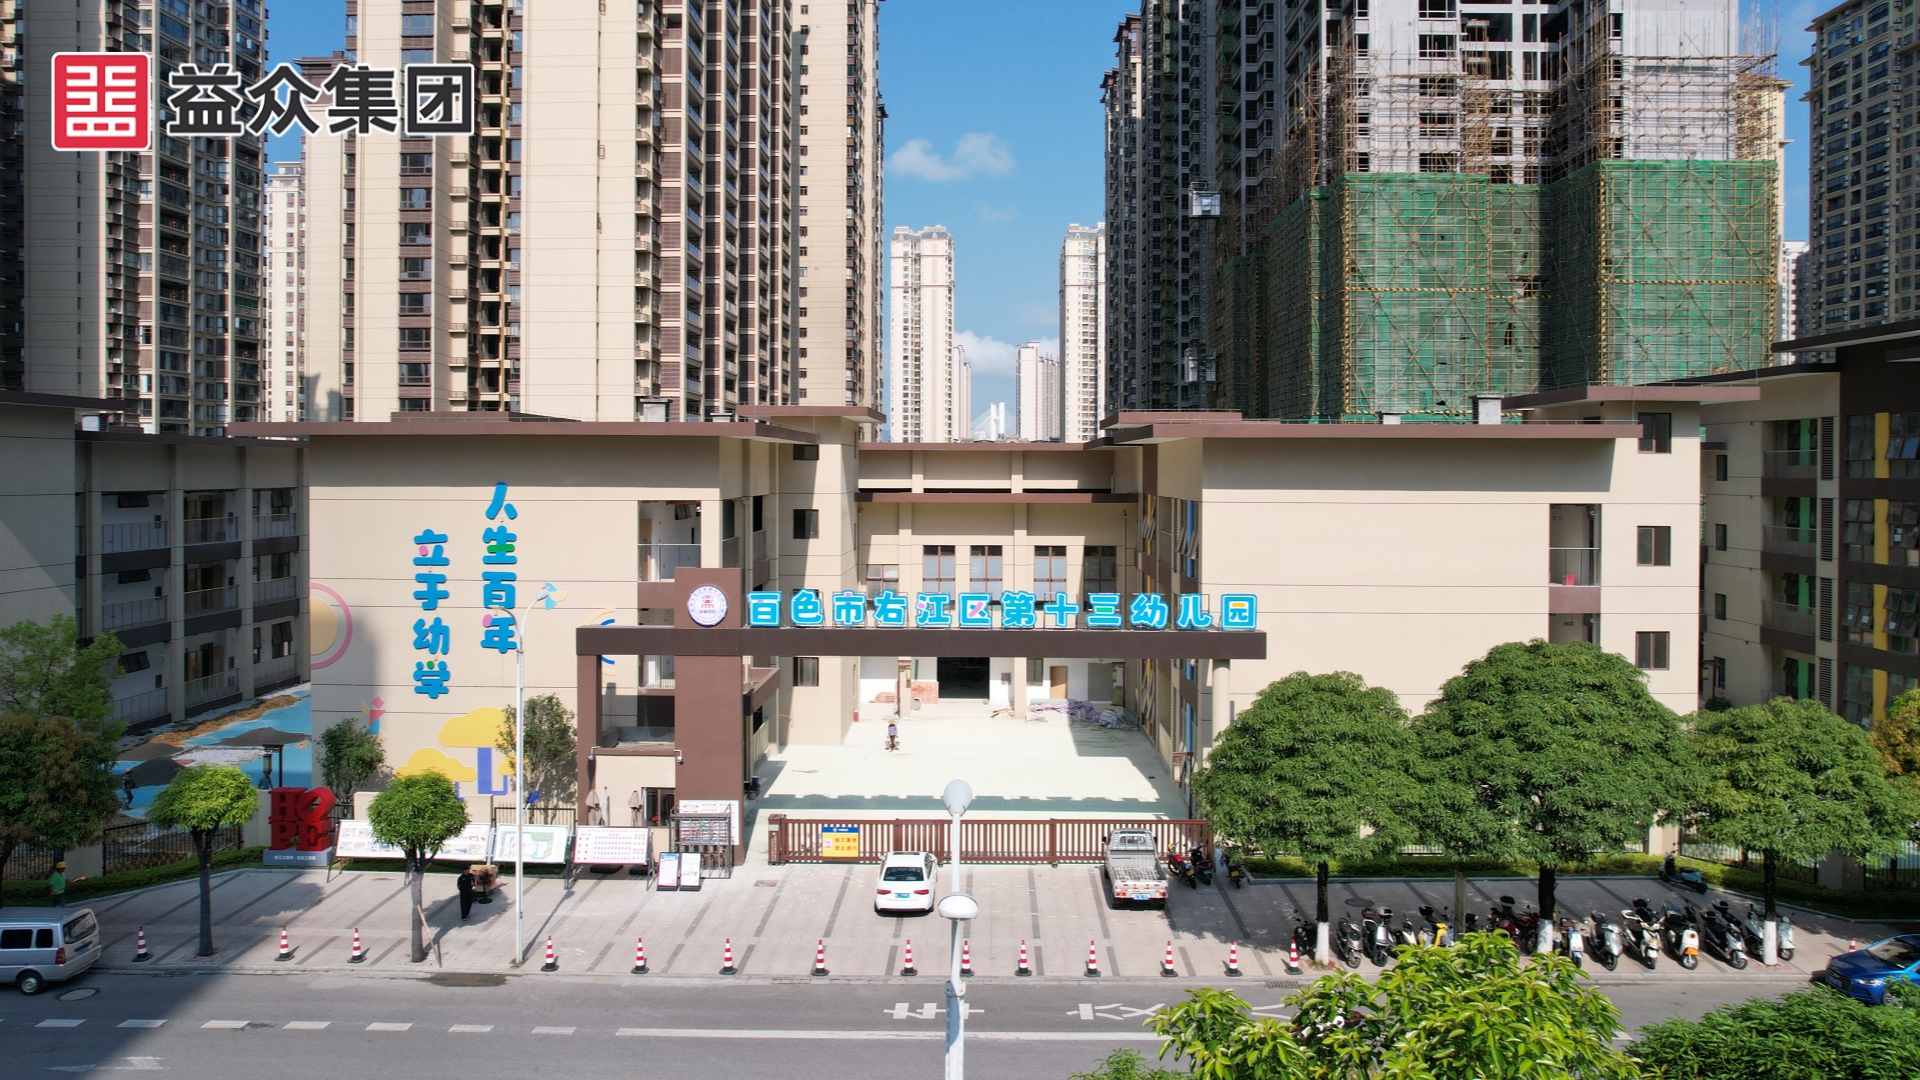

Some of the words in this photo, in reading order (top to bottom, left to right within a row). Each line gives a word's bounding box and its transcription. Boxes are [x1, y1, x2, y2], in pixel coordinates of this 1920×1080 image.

[412, 528, 451, 699] 立于幼学
[480, 482, 518, 654] 人生百年
[747, 589, 1259, 630] 百色市右江区第十三幼儿园
